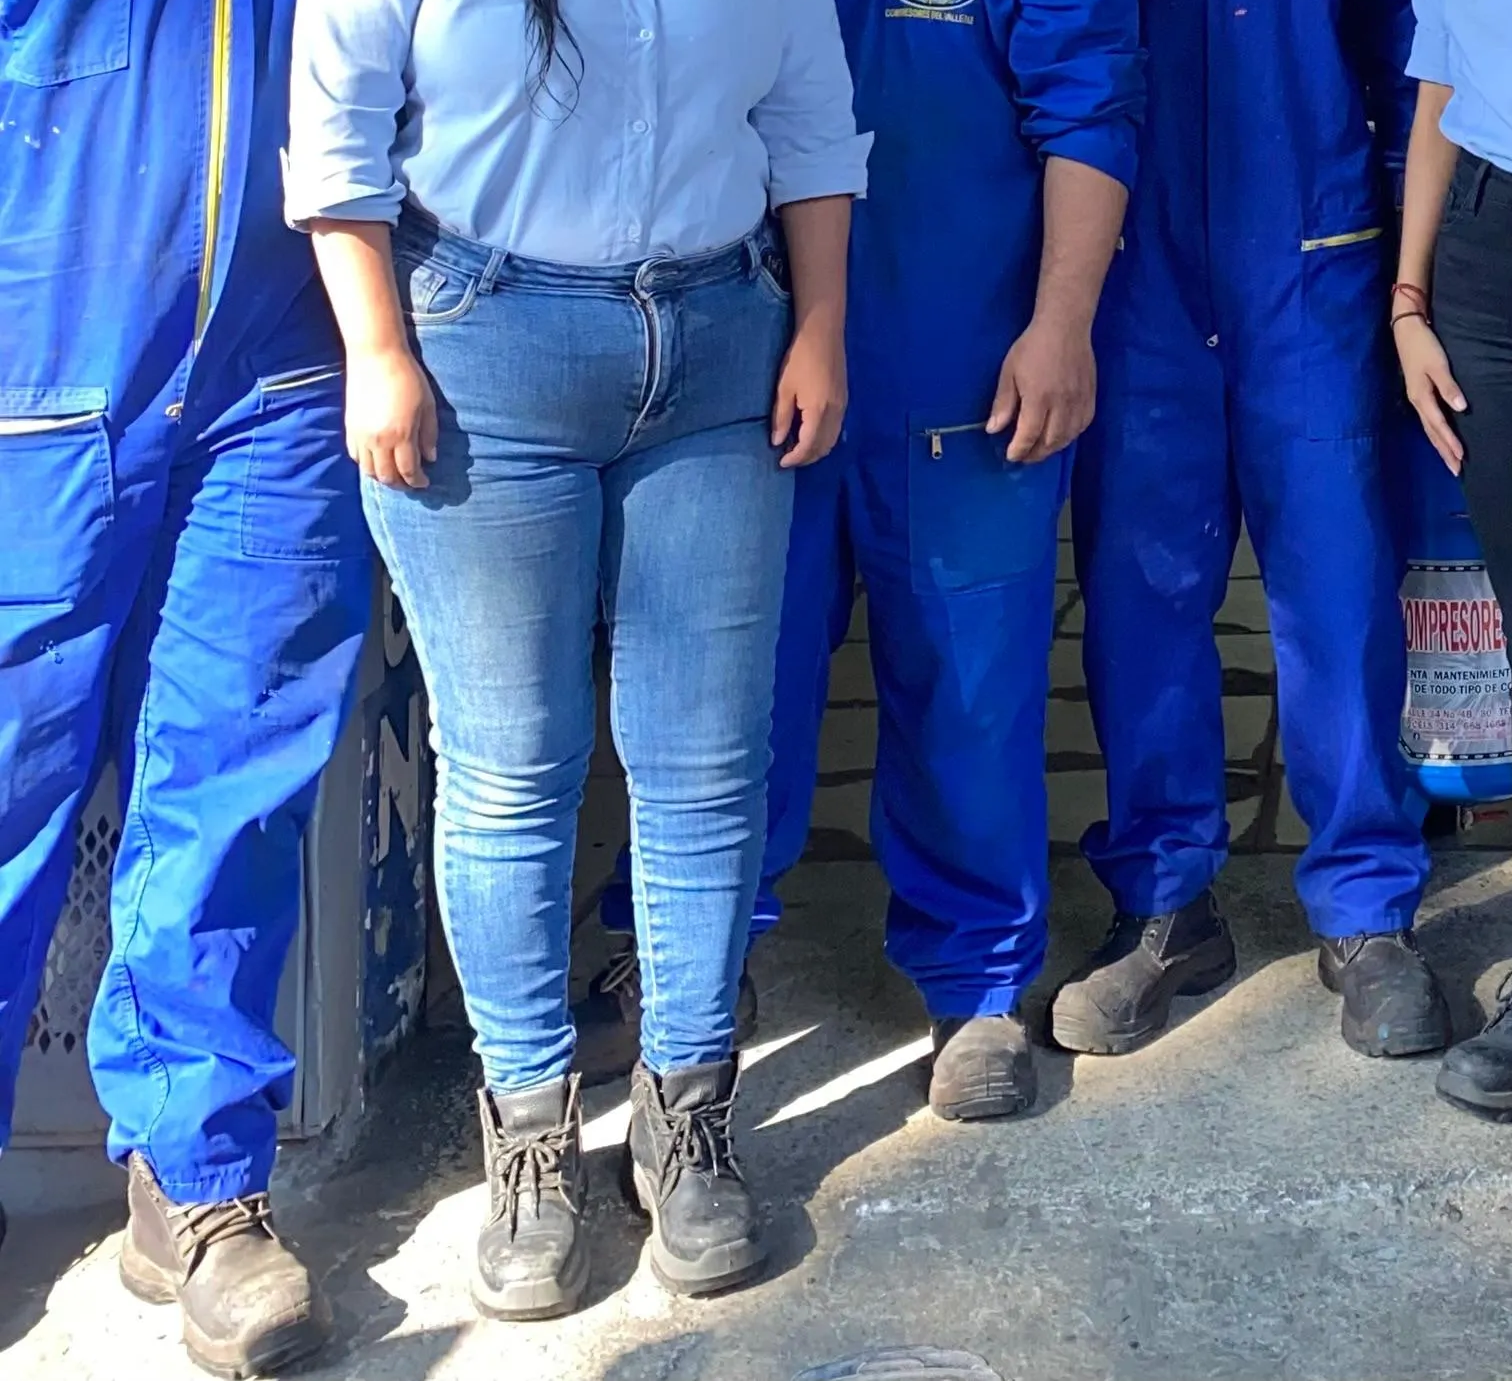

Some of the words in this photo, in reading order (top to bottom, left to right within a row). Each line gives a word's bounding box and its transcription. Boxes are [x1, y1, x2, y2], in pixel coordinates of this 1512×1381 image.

[1403, 599, 1507, 652] OMPRESORE
[1409, 669, 1428, 679] NTA
[1414, 684, 1427, 694] DE
[1430, 684, 1456, 694] TODO
[1460, 684, 1482, 694] TIPO
[1485, 683, 1497, 693] DE
